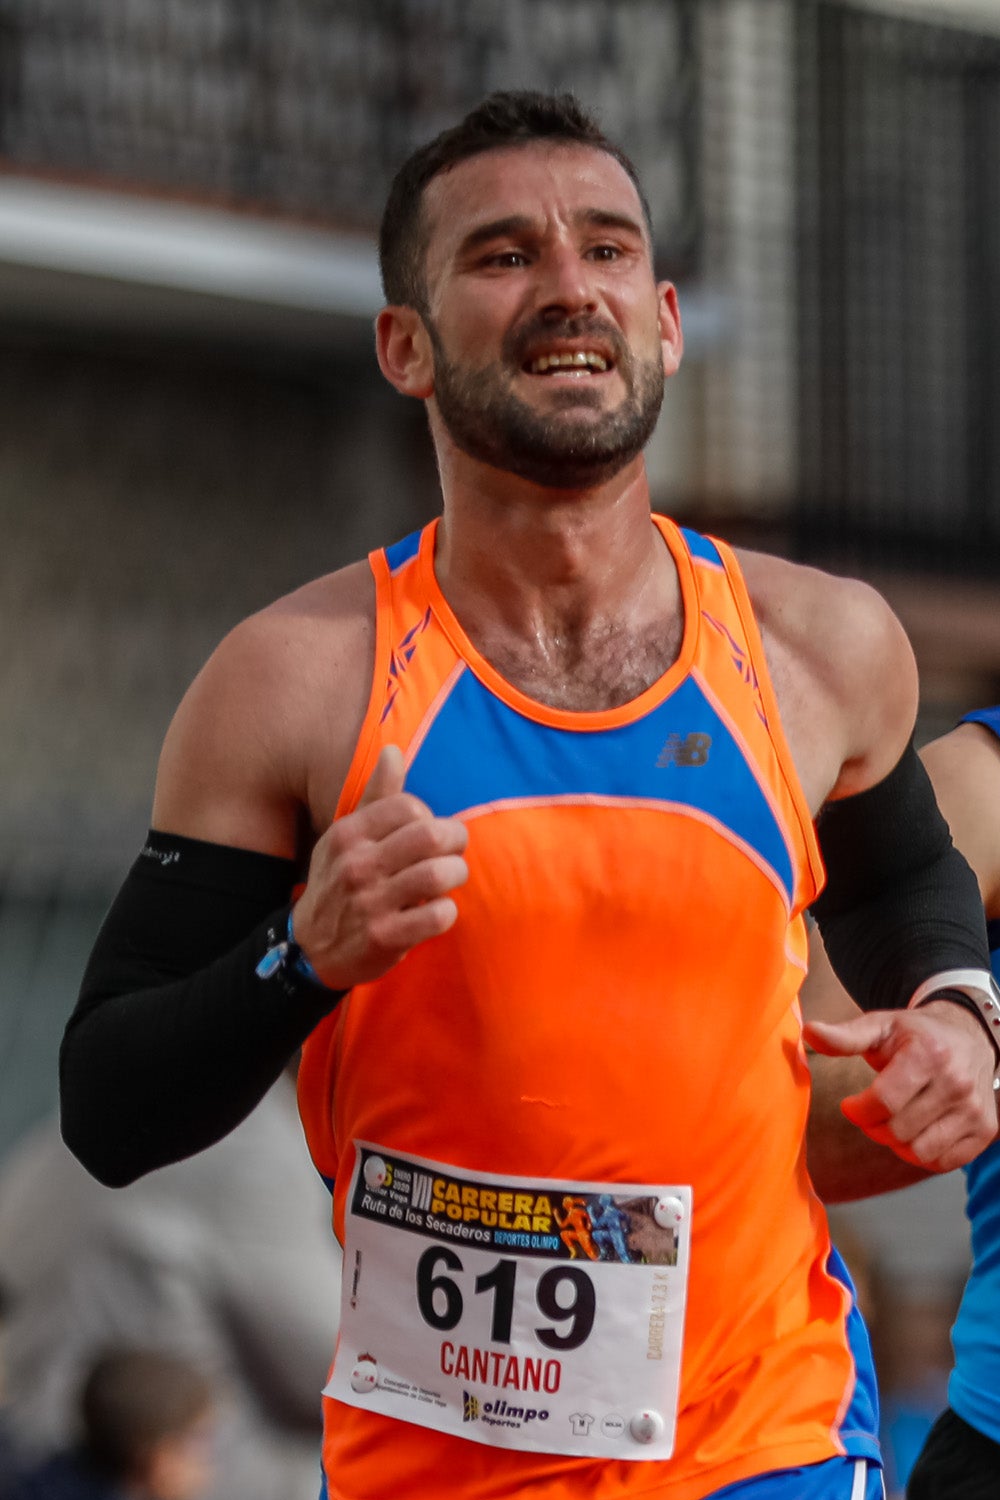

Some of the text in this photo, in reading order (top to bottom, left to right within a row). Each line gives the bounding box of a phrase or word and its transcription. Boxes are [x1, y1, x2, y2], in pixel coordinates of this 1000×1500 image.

[361, 1194, 387, 1215] Ruta
[389, 1204, 404, 1220] de
[405, 1208, 423, 1226] los
[425, 1214, 491, 1242] Secaderos
[431, 1198, 552, 1233] POPULAR
[433, 1179, 552, 1216] CARRERA
[416, 1245, 596, 1351] 619
[440, 1341, 562, 1395] CANTANO
[483, 1400, 550, 1424] olimpo
